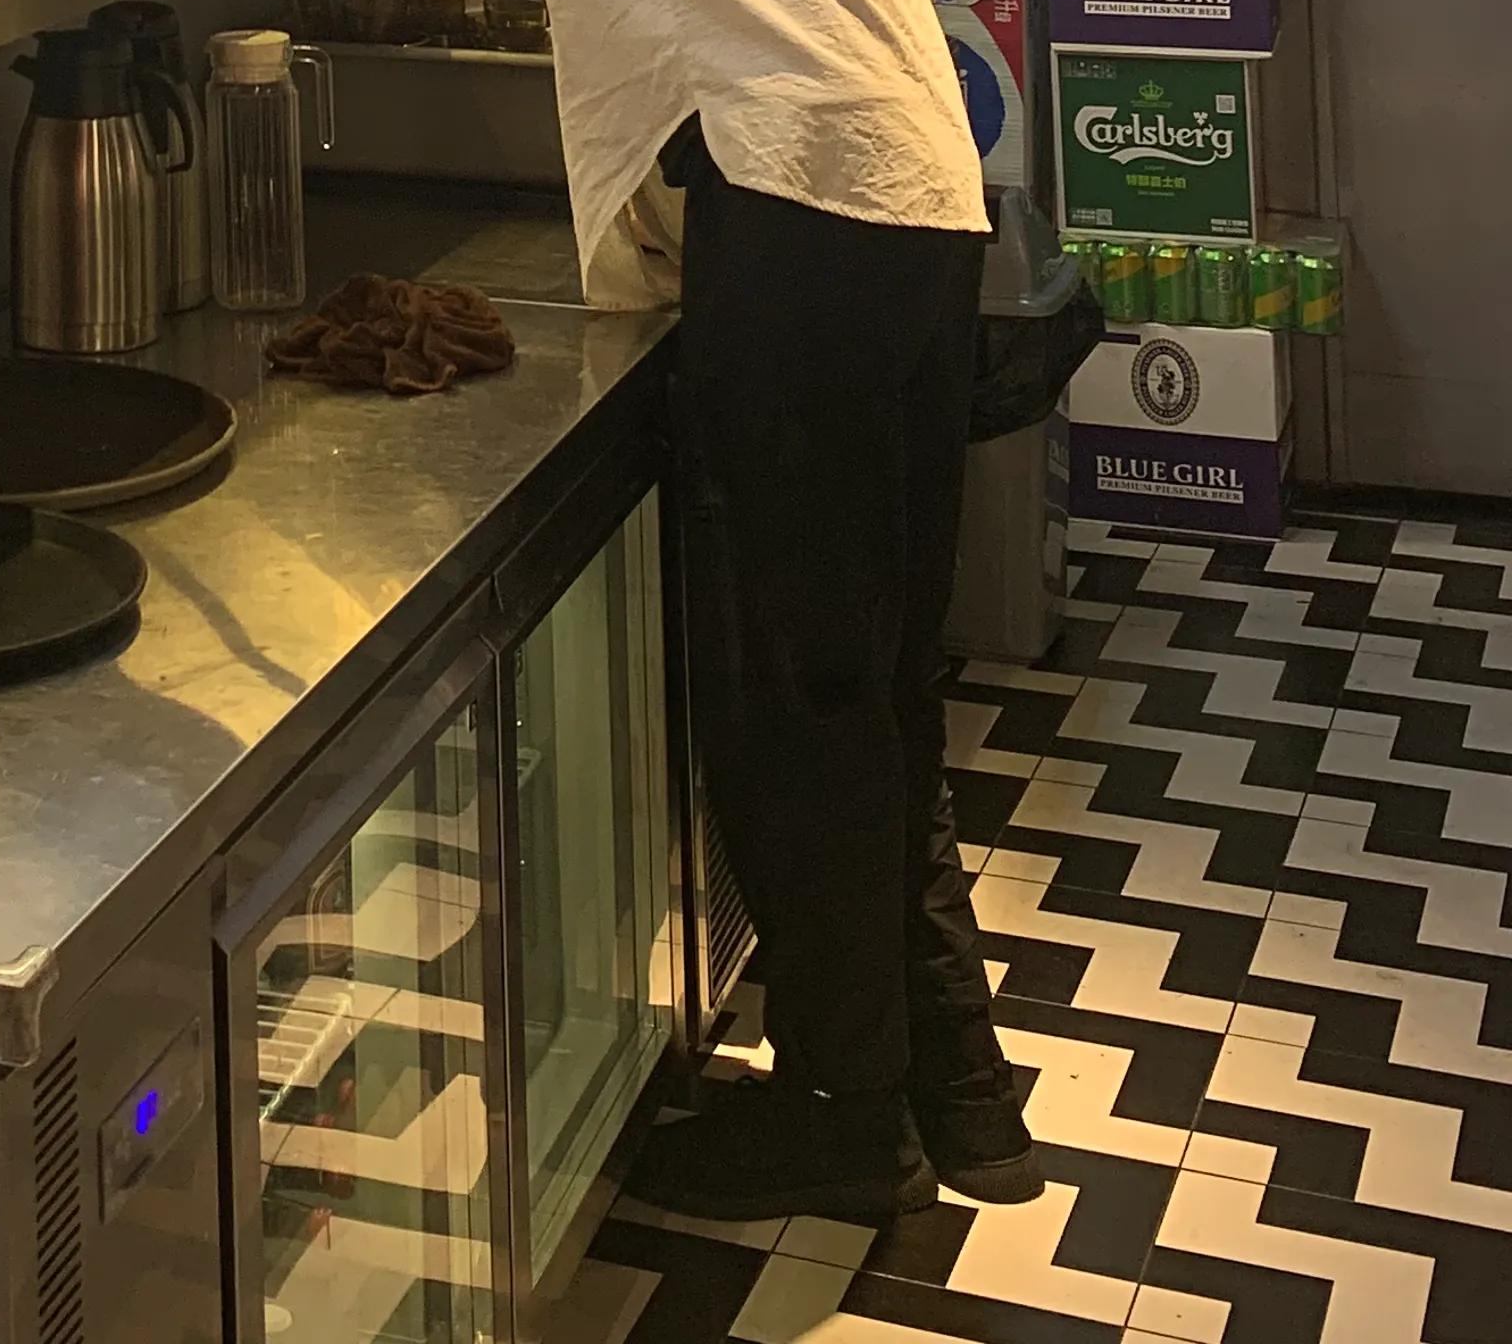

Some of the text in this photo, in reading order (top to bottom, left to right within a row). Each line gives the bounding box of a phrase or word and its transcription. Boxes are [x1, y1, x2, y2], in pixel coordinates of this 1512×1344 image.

[1088, 3, 1228, 17] PREMIUM PILSENER BEER
[1074, 105, 1234, 162] Carlsberg
[1096, 454, 1244, 489] BLUE GIRL
[1100, 479, 1242, 501] PREMIUM PILSENER BEER
